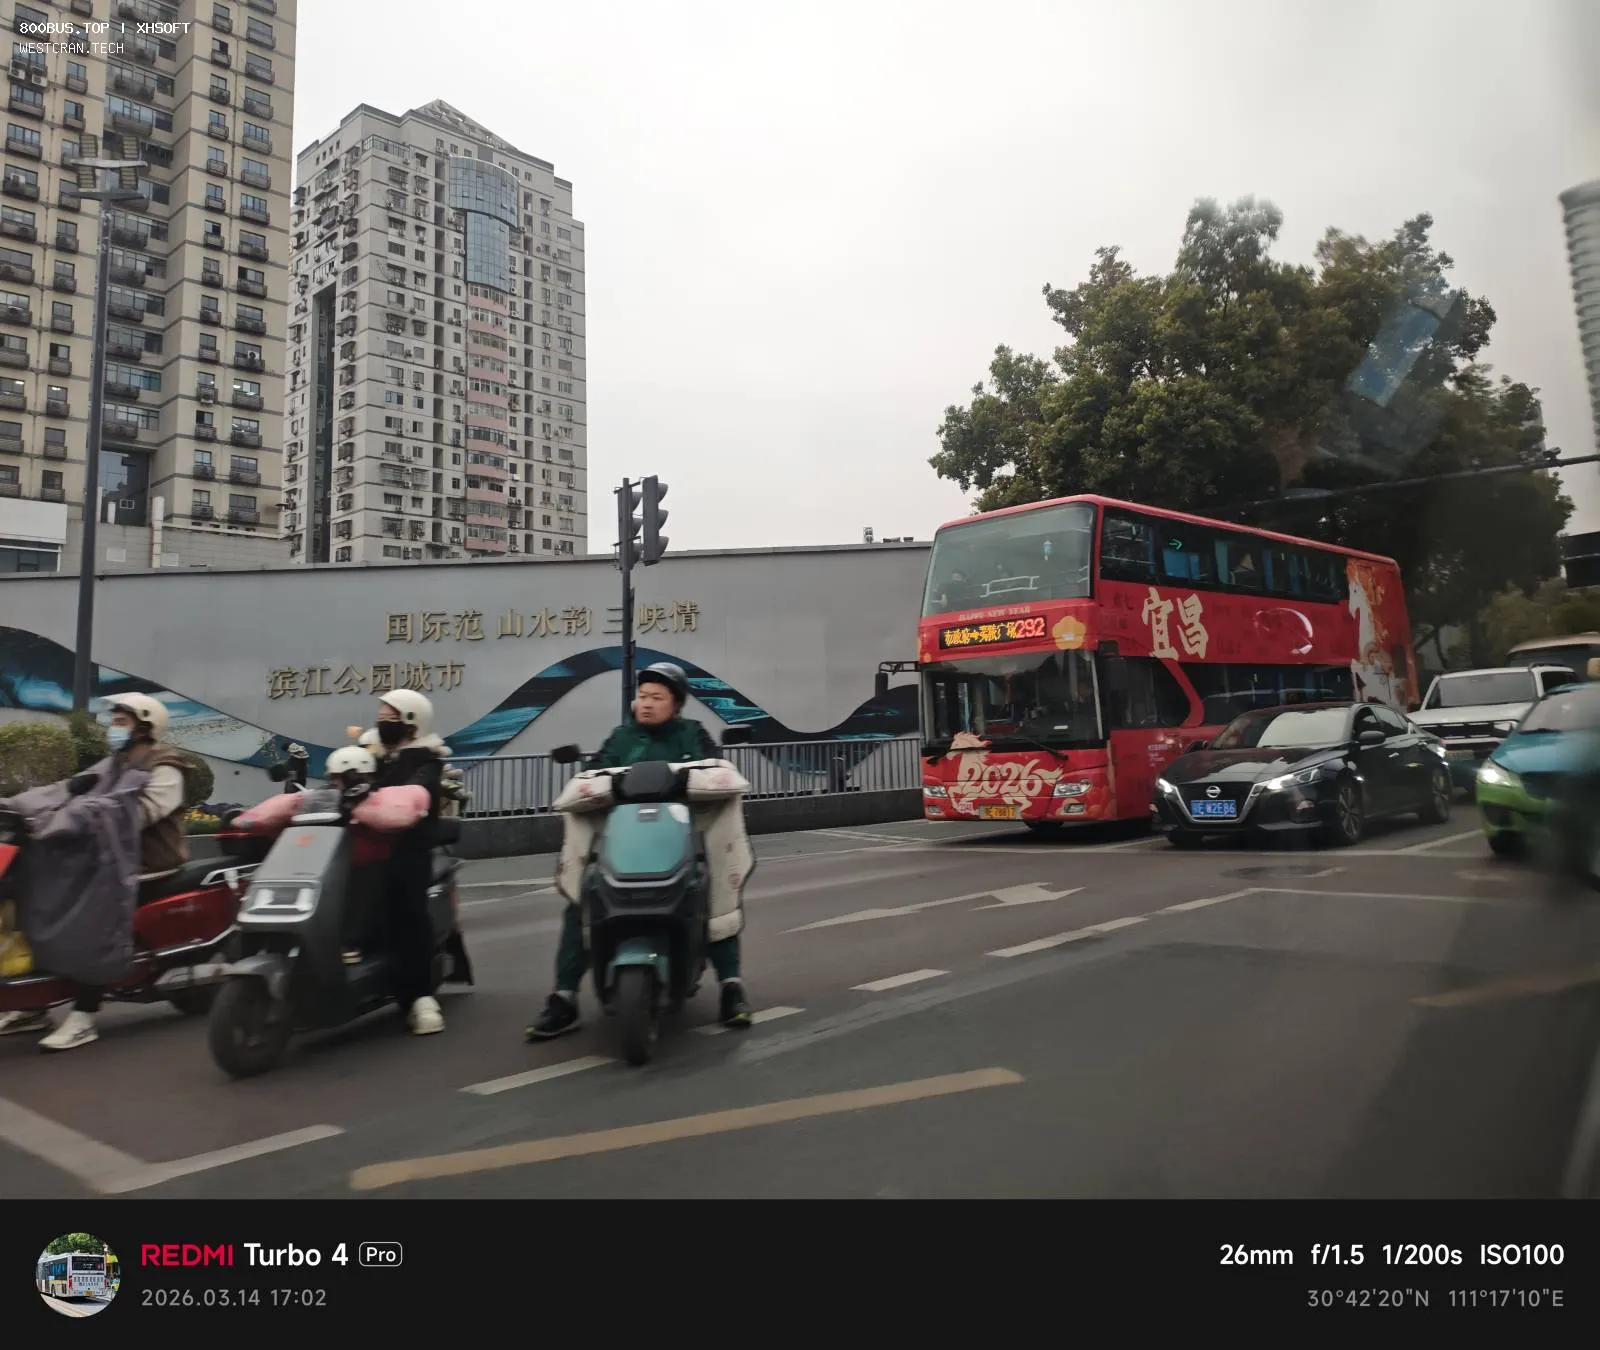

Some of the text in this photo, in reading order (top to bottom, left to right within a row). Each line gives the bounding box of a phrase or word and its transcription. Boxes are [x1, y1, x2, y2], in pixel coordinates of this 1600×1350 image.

[385, 600, 701, 644] 国际范 山水韵 三峡情
[1015, 617, 1046, 639] 292
[1141, 586, 1209, 662] 宜昌
[267, 660, 467, 700] 滨江公园城市
[962, 758, 1043, 797] 2026
